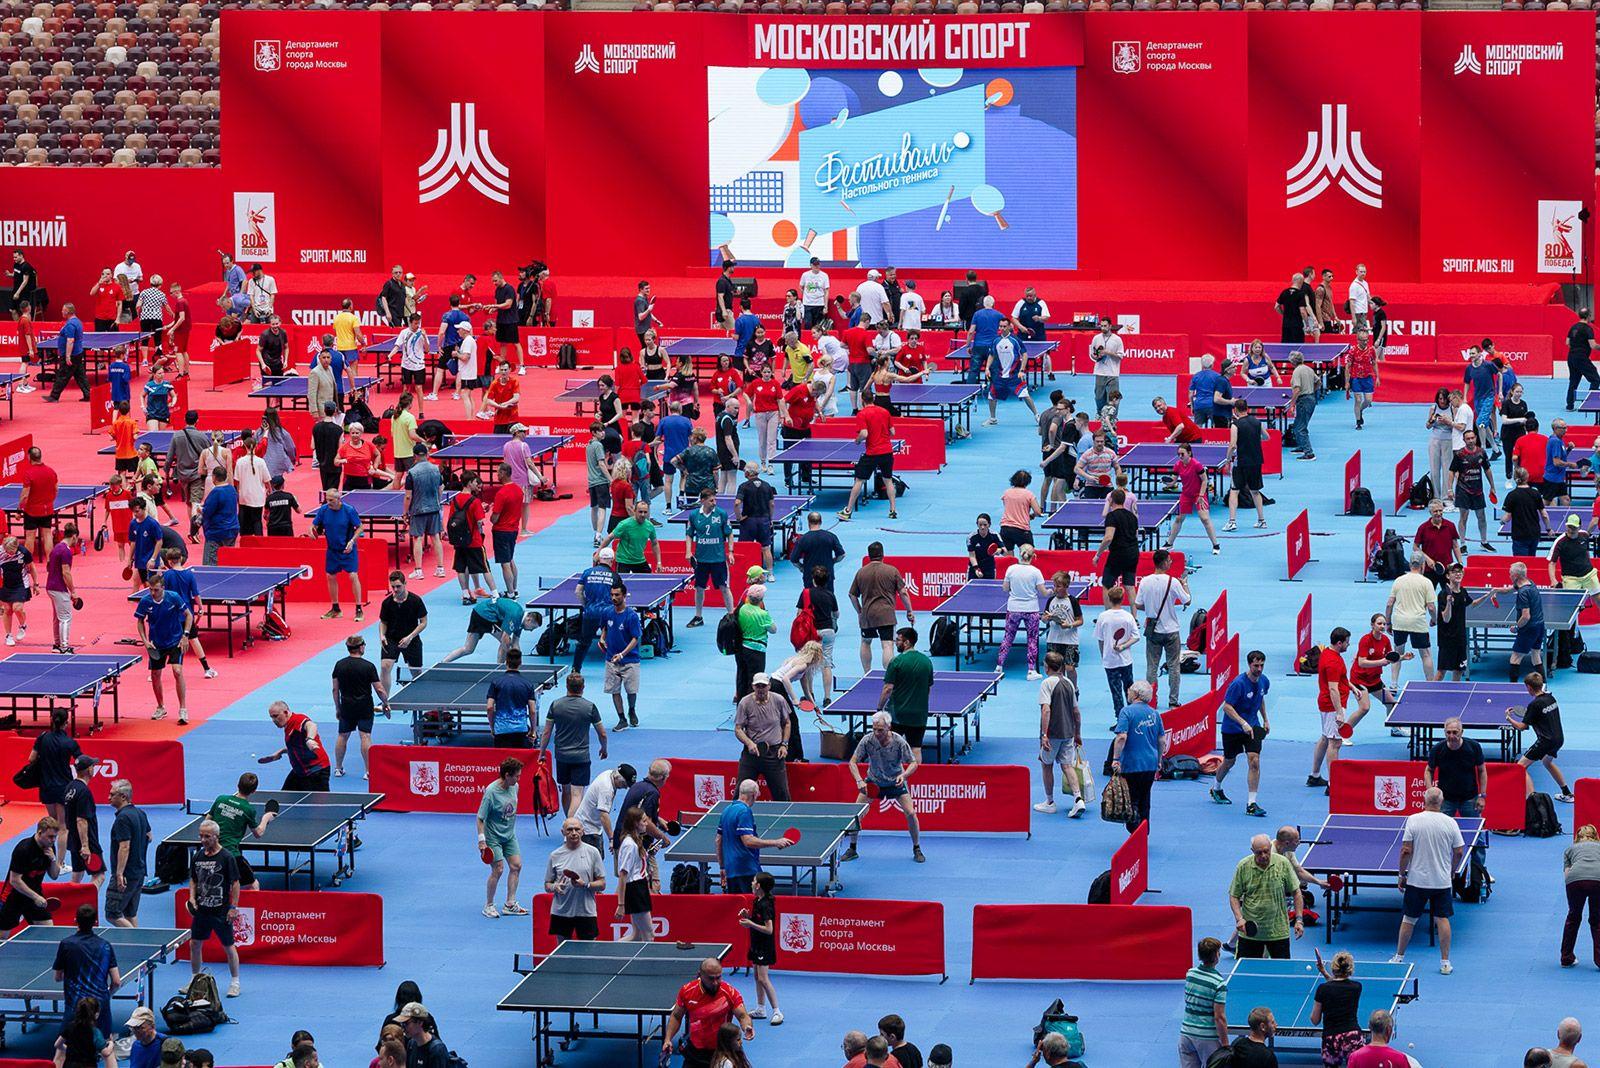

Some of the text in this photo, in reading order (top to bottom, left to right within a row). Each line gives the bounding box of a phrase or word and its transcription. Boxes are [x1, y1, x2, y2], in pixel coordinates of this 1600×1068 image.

[285, 40, 339, 50] Департамент
[755, 19, 1031, 61] МОСКОВСКИЙ СПОРТ
[1146, 40, 1204, 52] Департамент
[285, 51, 314, 60] спорта
[603, 41, 677, 60] МОСКОВСКИЙ
[1146, 52, 1176, 61] спорта
[1485, 41, 1564, 60] МОСКОВСКИЙ
[286, 60, 348, 69] города Москвы
[603, 59, 638, 75] СПОРТ
[1146, 61, 1213, 71] города Москвы
[1485, 60, 1523, 75] СПОРТ
[815, 131, 955, 194] Фестиваль
[841, 167, 939, 200] Настольного тенниса
[0, 215, 67, 247] ВСКИЙ
[241, 233, 258, 247] 80
[241, 248, 269, 256] ПОБЕДА!
[300, 249, 367, 263] SPORT.MOS.RU
[1544, 243, 1562, 259] 80
[1442, 257, 1515, 274] SPORT.MOS.RU
[1544, 258, 1575, 267] ПОБЕДА!
[1121, 348, 1176, 359] МПИОНАТ
[705, 524, 711, 536] 2
[922, 572, 968, 586] МОСКОВС
[922, 585, 951, 597] СПОРТ
[1171, 715, 1209, 746] ЧЕМПИОНАТ
[444, 775, 475, 784] спорта
[444, 785, 475, 794] города
[909, 780, 988, 800] МОСКОВСКИЙ
[910, 799, 947, 814] СПОРТ
[260, 909, 327, 922] Департамент
[819, 915, 886, 929] Департамент
[260, 922, 296, 933] спорта
[819, 928, 854, 940] спорта
[260, 933, 338, 945] города Москвы
[819, 940, 897, 952] города Москвы
